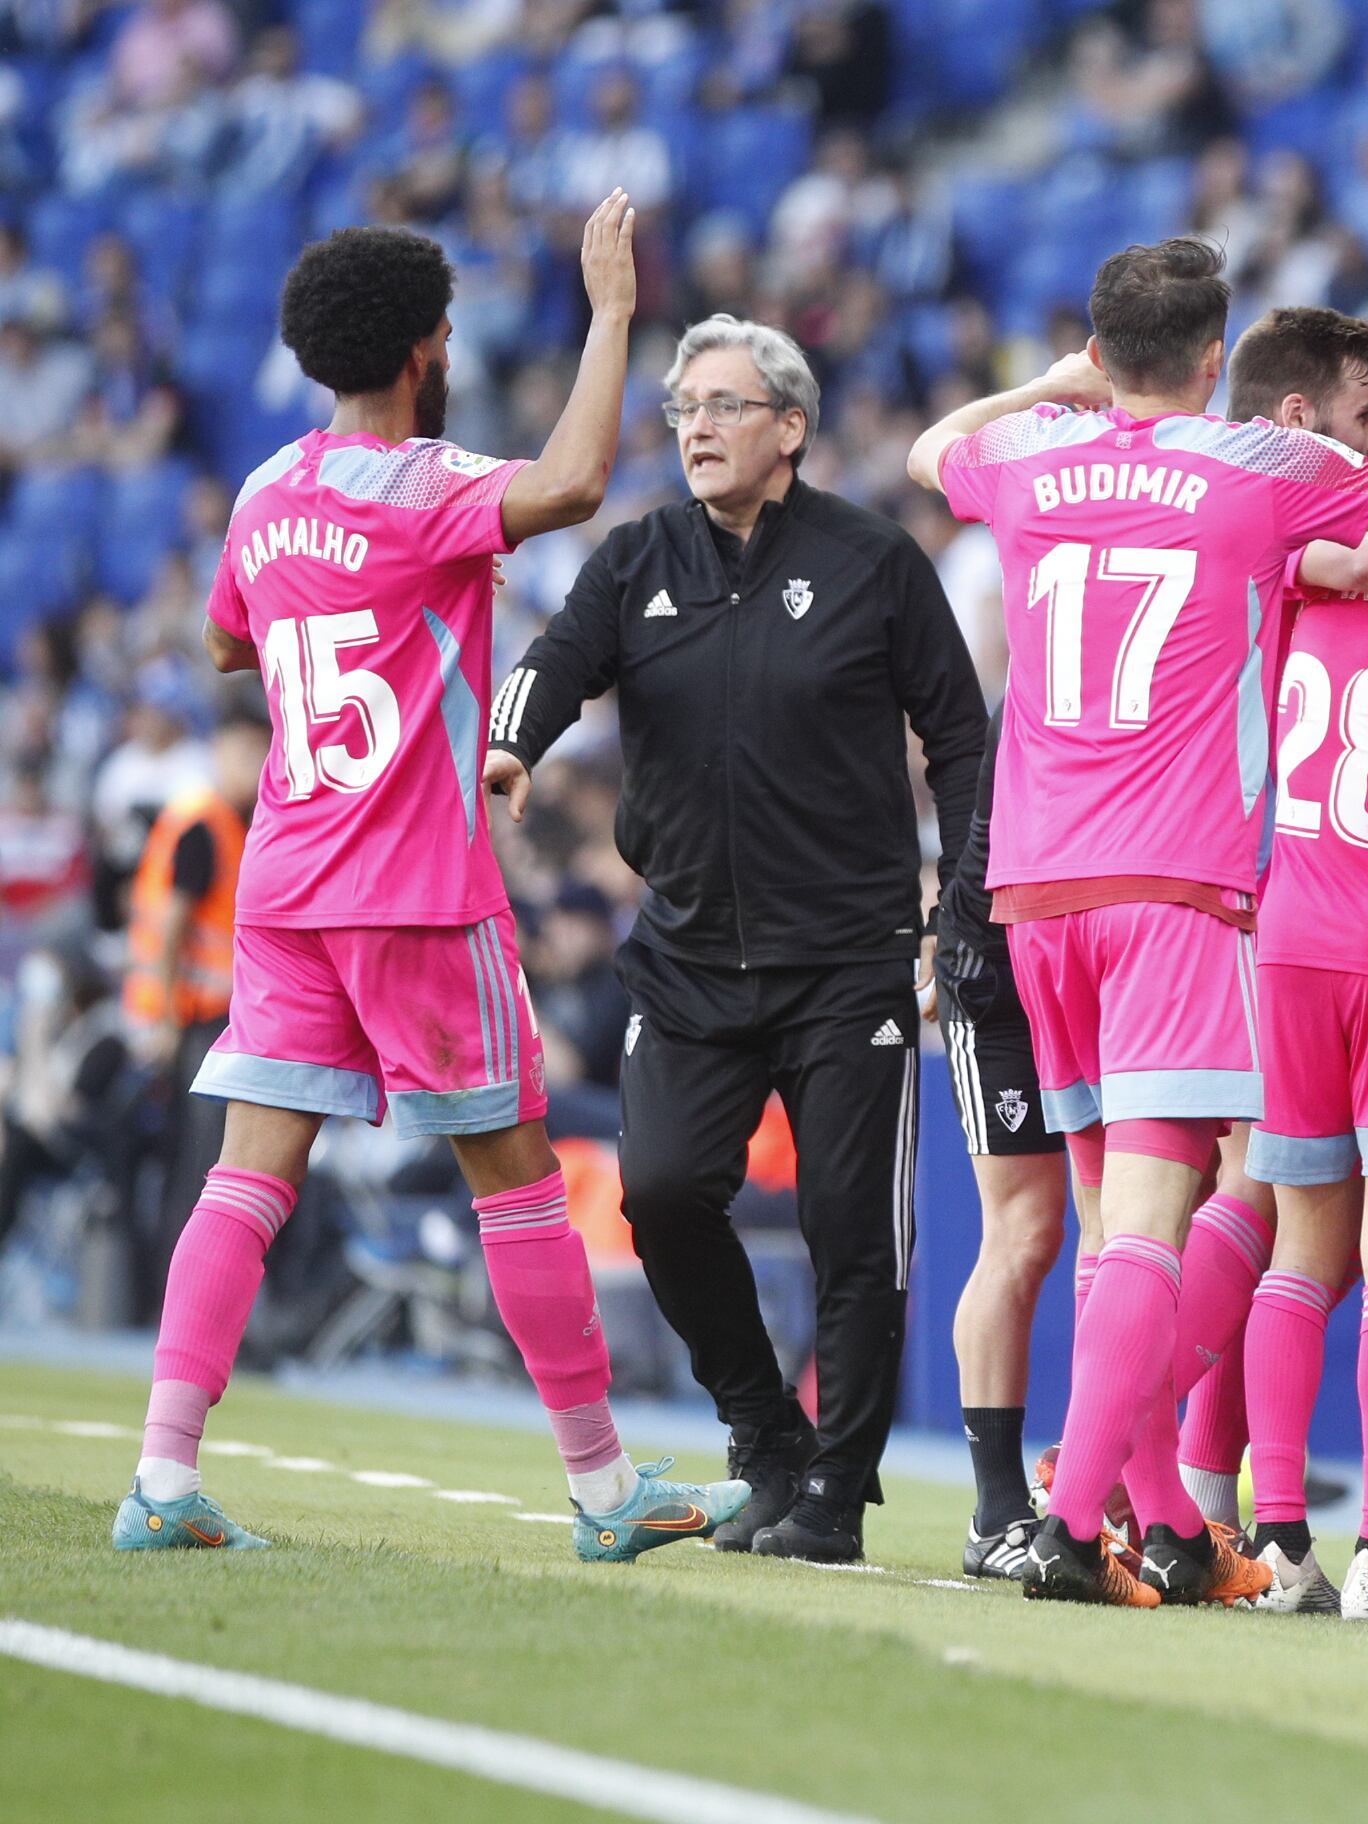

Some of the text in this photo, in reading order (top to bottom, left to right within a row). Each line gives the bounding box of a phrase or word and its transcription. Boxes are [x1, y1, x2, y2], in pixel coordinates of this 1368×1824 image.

[1032, 463, 1209, 514] BUDIMIR
[240, 516, 370, 585] RAMALHO
[643, 606, 678, 618] adidas
[1027, 542, 1199, 731] 17
[261, 608, 402, 802] 15
